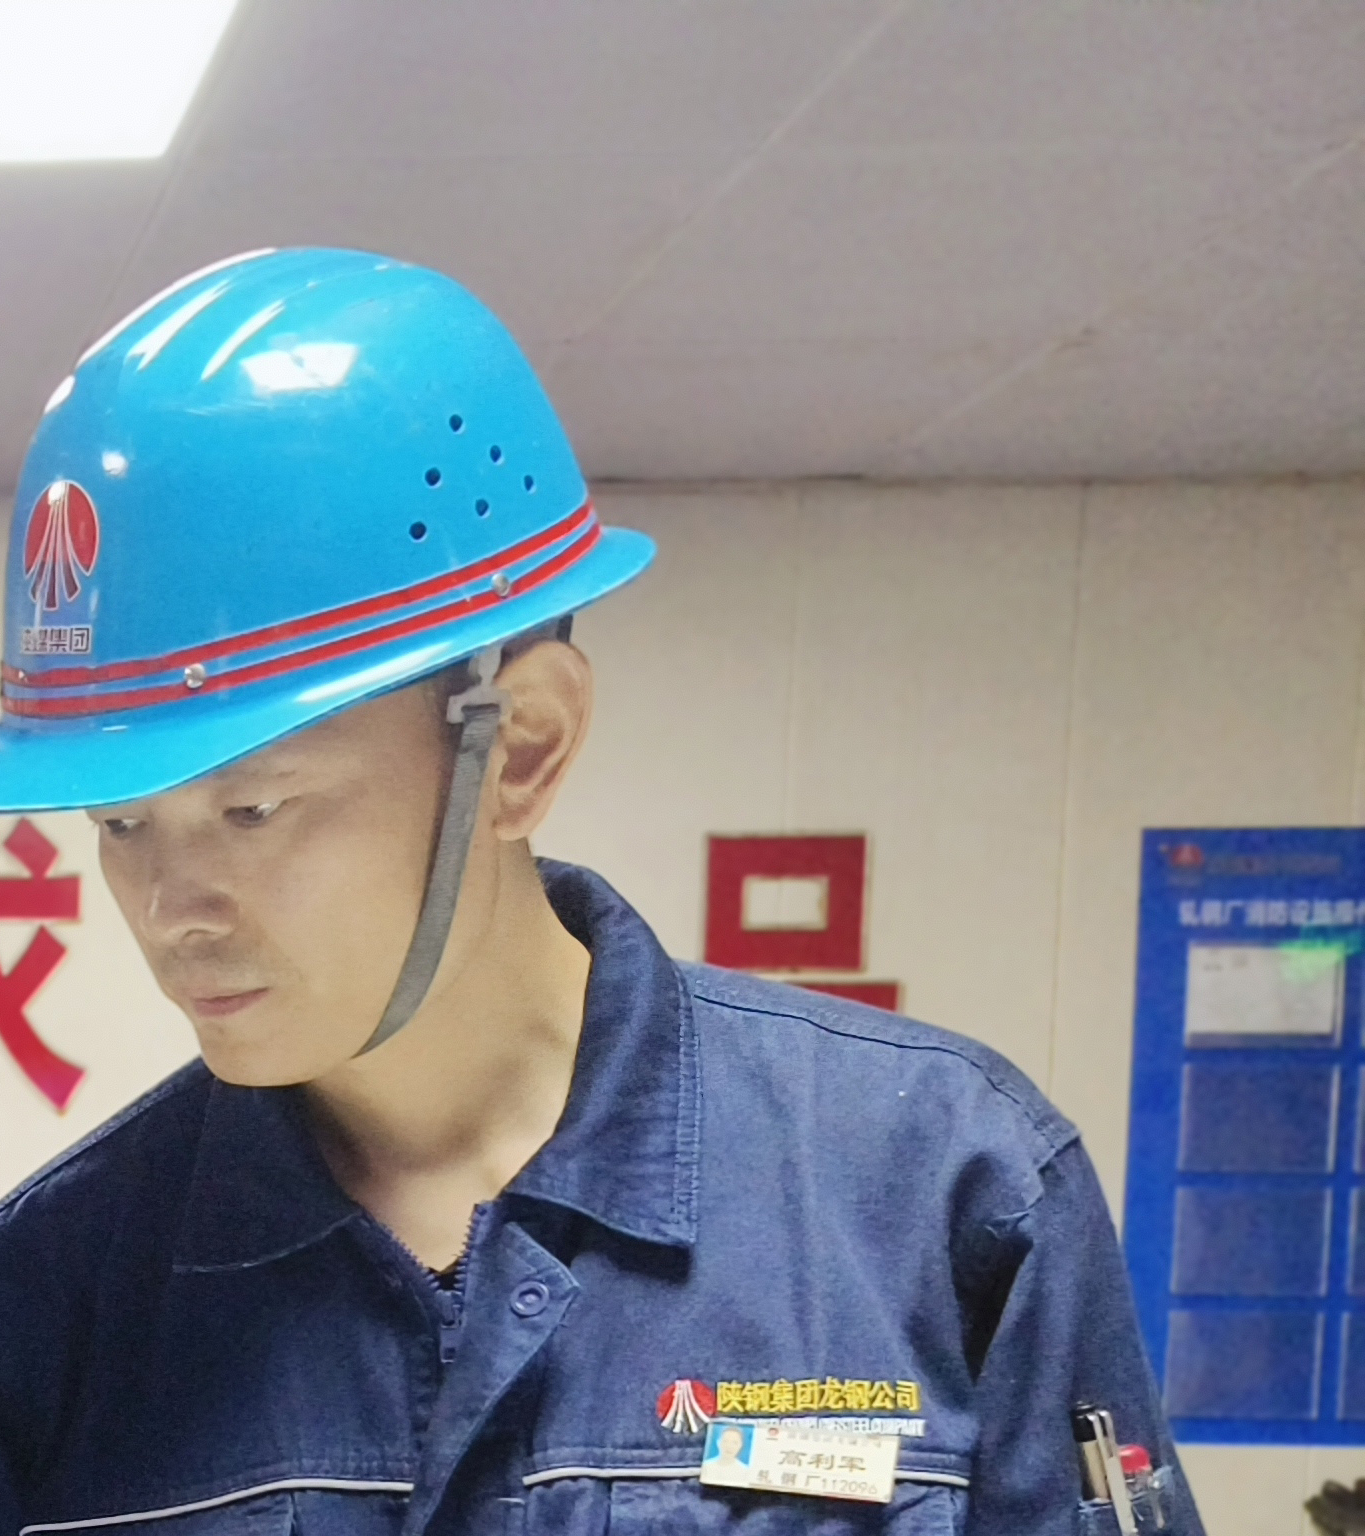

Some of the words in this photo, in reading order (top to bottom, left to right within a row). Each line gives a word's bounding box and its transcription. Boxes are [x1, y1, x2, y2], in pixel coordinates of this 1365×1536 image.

[716, 1377, 920, 1412] 陕钢集团龙钢公司
[777, 1449, 867, 1472] 高利军
